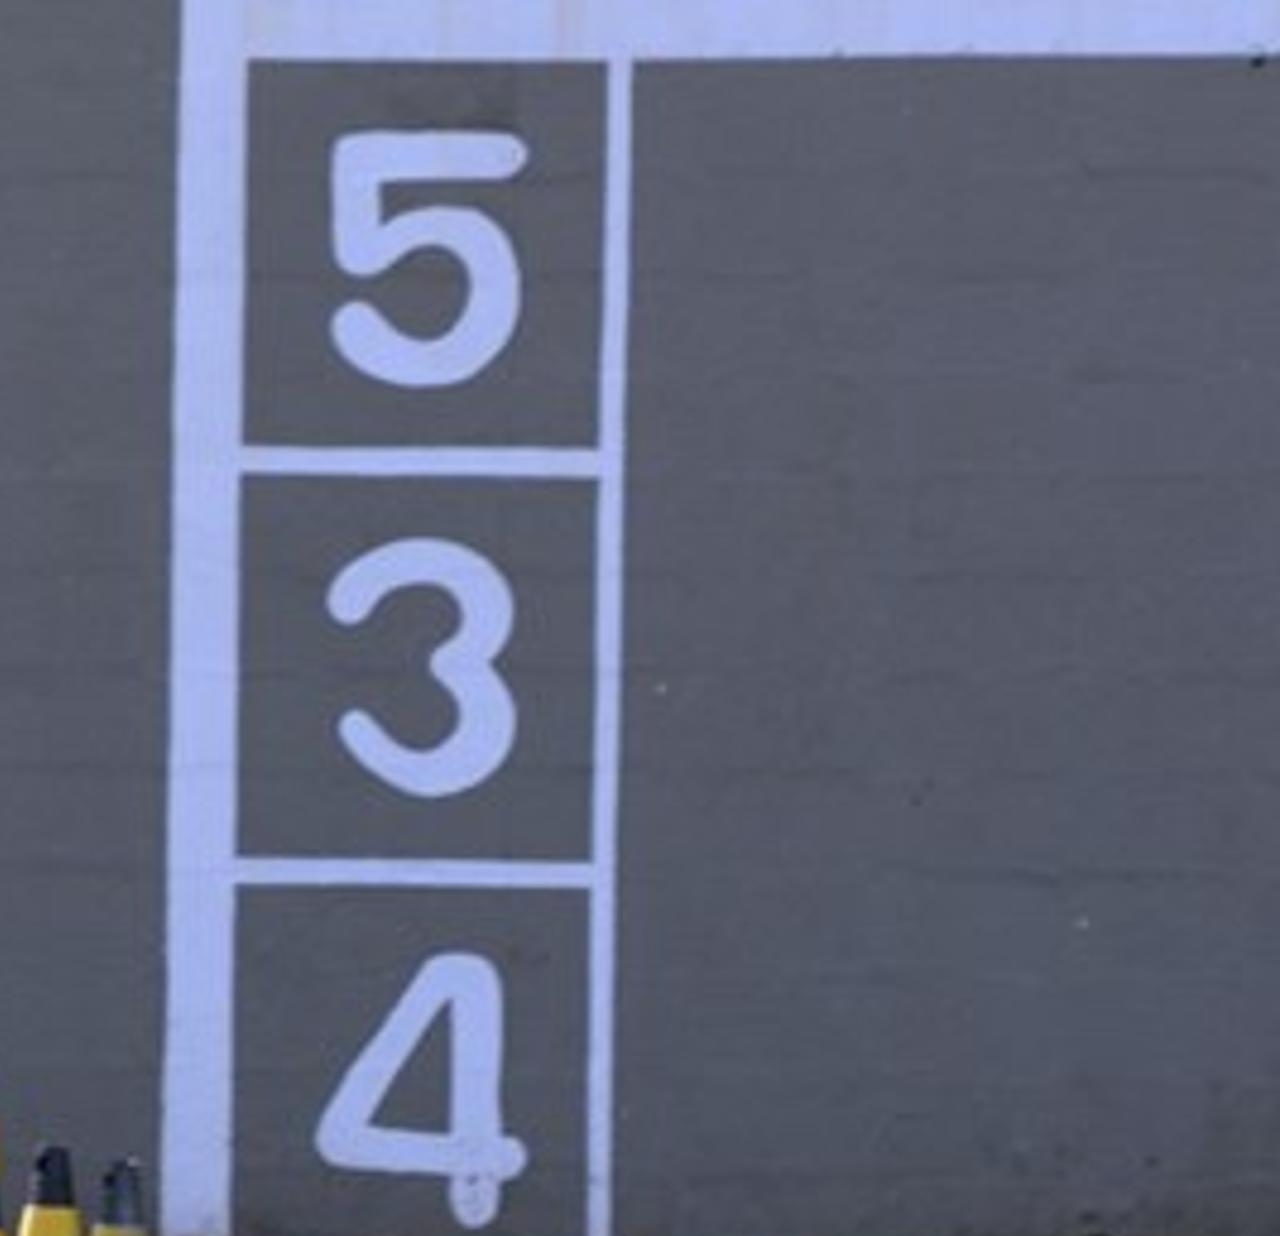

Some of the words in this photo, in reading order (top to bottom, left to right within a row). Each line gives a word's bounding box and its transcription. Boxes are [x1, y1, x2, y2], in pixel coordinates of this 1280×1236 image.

[332, 131, 527, 386] 5
[328, 539, 516, 797] 3
[316, 953, 526, 1226] 4
